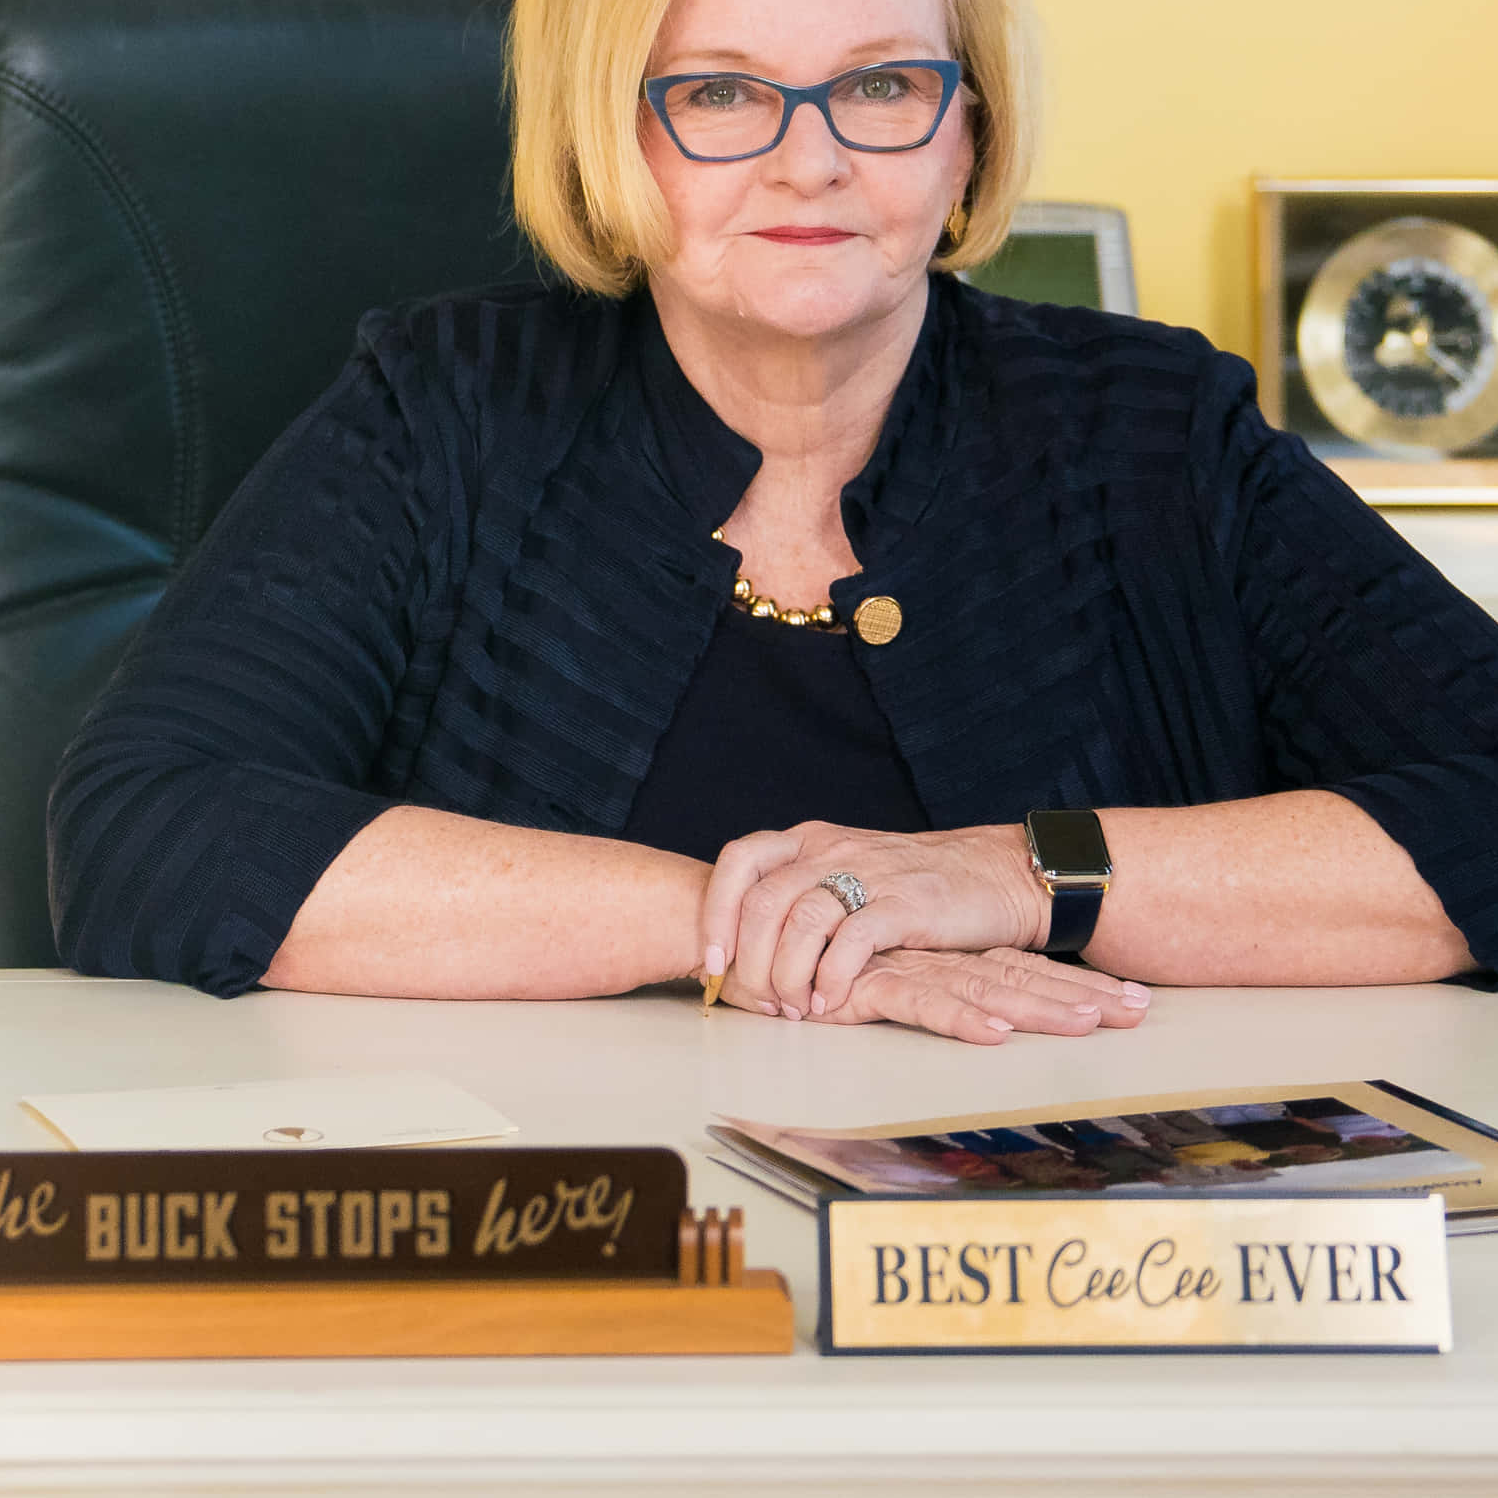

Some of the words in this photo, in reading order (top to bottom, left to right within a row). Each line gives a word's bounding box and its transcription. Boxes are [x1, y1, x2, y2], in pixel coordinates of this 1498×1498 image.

[84, 1191, 240, 1261] BUCK
[264, 1189, 452, 1260] STOPS
[472, 1174, 634, 1258] here!
[870, 1245, 1034, 1306] BEST
[1234, 1243, 1414, 1304] EVER
